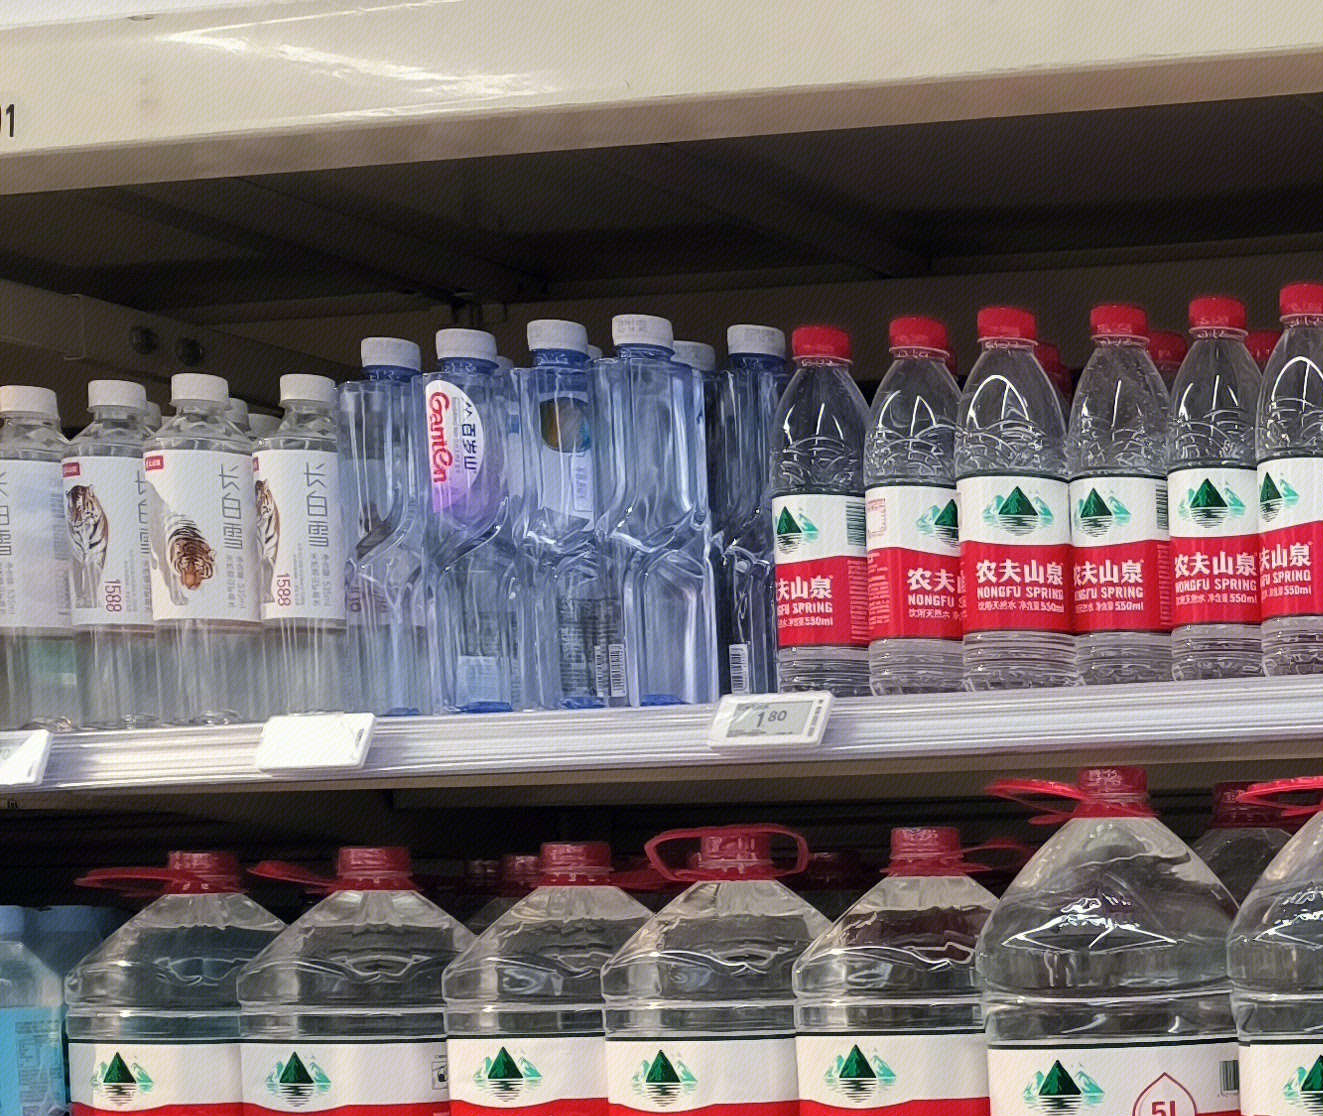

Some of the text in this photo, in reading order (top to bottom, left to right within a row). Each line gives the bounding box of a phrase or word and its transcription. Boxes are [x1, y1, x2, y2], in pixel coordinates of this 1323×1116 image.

[0, 104, 15, 138] 1
[1175, 551, 1257, 576] 农夫山泉
[976, 559, 1064, 585] 农夫山泉
[1273, 568, 1311, 583] SPRING
[775, 574, 834, 600] 夫山泉
[1100, 584, 1144, 599] SPRING
[1214, 577, 1257, 591] SPRING
[977, 584, 1064, 600] NONGFU SPRING
[792, 600, 833, 614] SPRING
[907, 594, 955, 607] NONGFU
